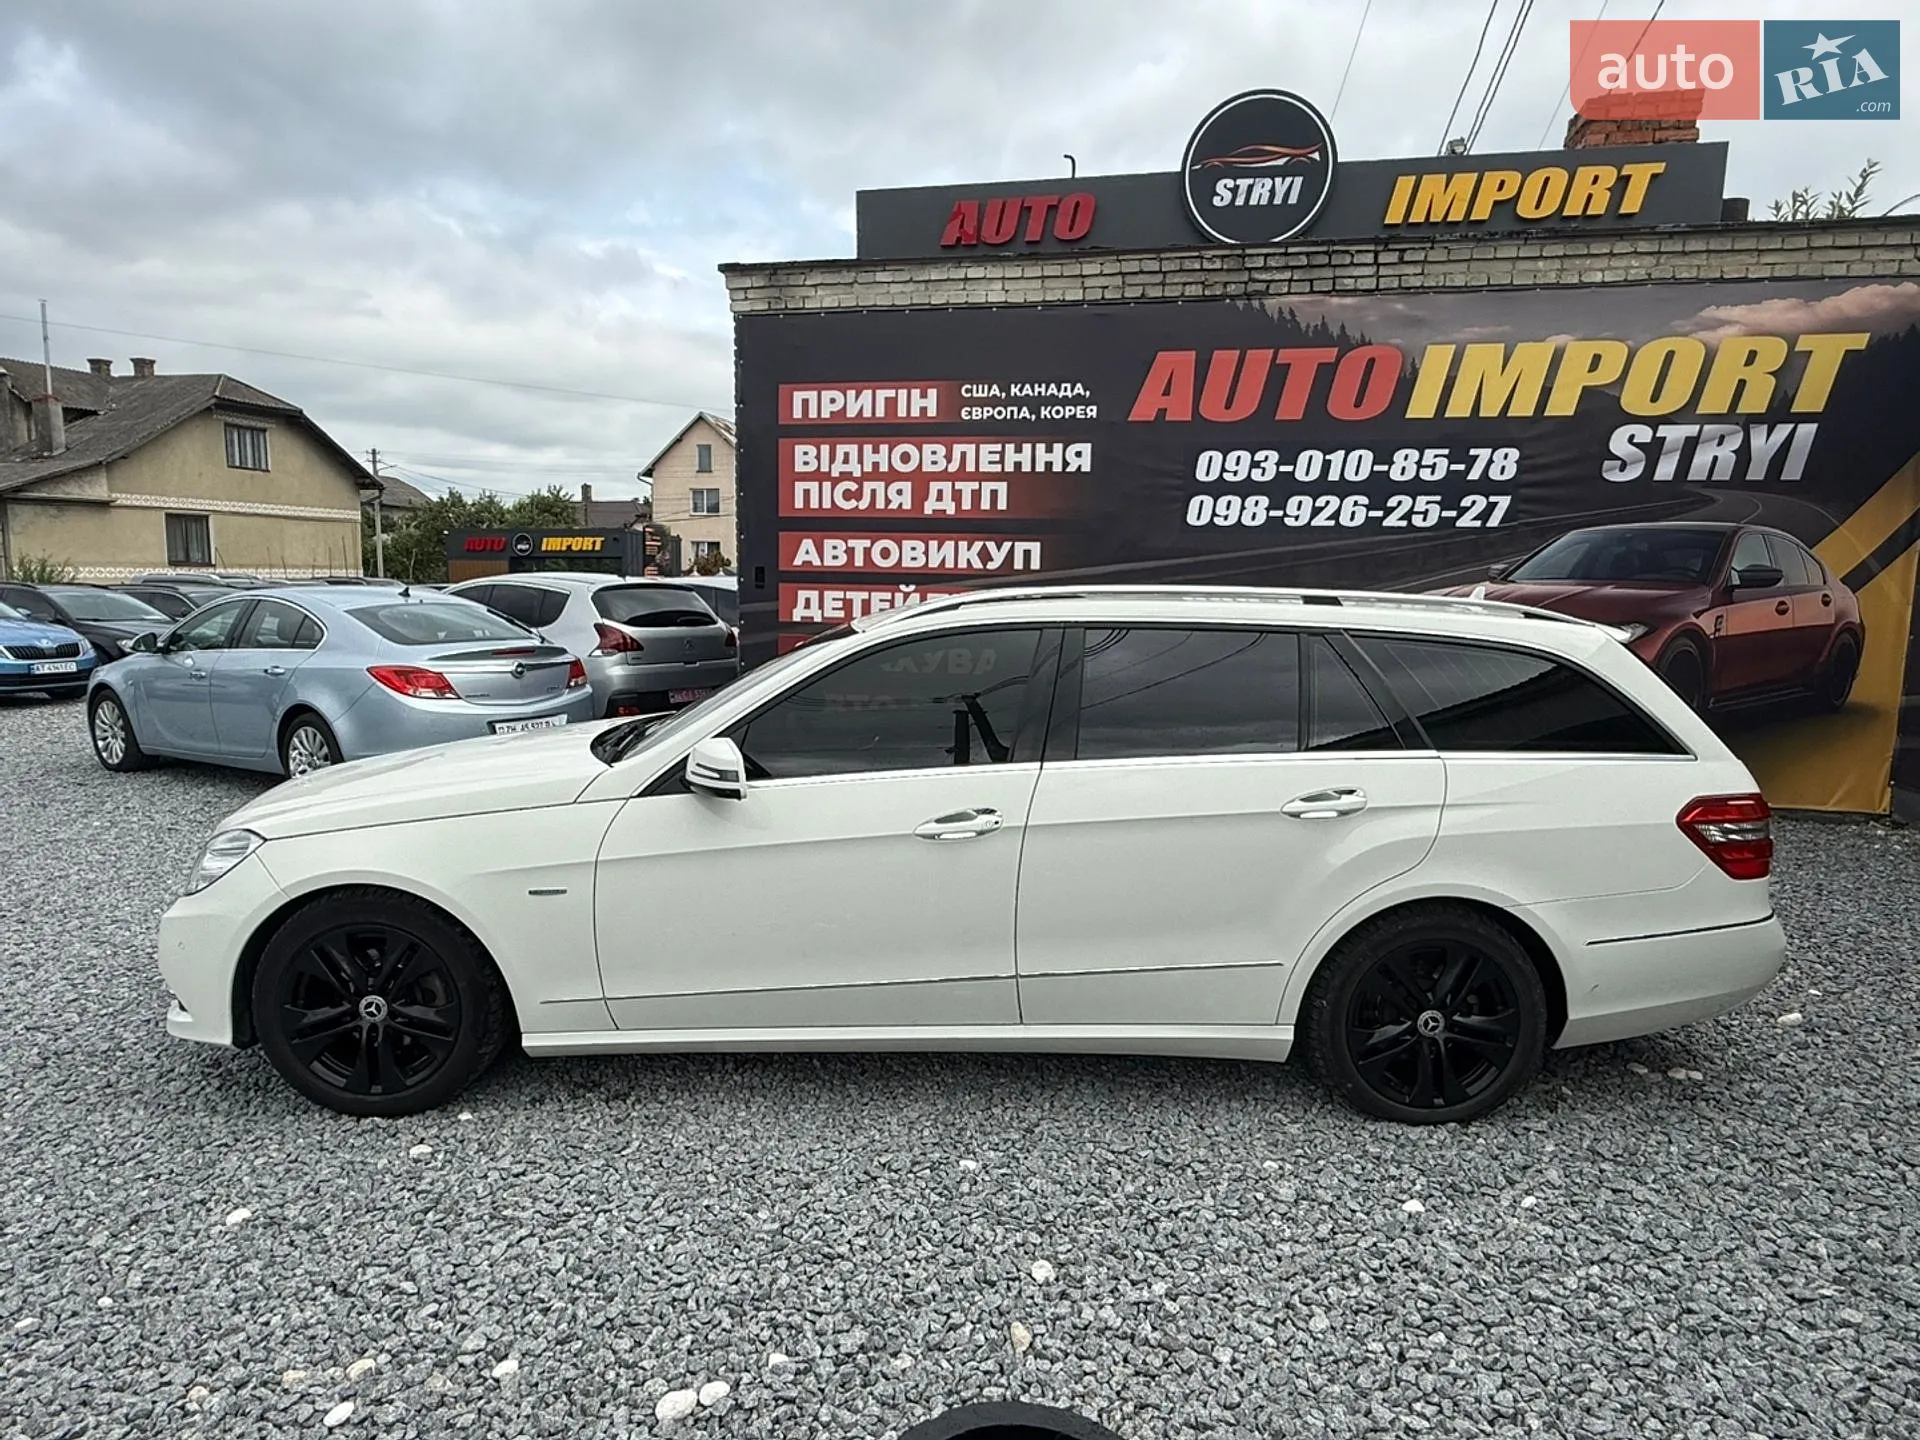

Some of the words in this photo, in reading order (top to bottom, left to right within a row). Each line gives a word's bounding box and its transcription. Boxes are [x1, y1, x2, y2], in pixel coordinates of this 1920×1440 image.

[1212, 176, 1304, 207] STRYI
[1384, 161, 1667, 226] IMPORT
[940, 192, 1096, 247] AUTO
[792, 388, 938, 419] ПРИГІН
[961, 384, 1006, 401] США,
[1010, 383, 1091, 400] КАНАДА,
[961, 406, 1036, 422] ЄВРОПА,
[1040, 405, 1097, 420] КОРЕЯ
[794, 442, 1093, 477] ВІДНОВЛЕННЯ
[1194, 446, 1521, 483] 093-010-85-78
[1601, 422, 1819, 483] STRYI
[794, 481, 912, 510] ПІСЛЯ
[924, 481, 1009, 515] ДТП
[1185, 494, 1513, 528] 098-926-25-27
[541, 537, 605, 552] IMPORT
[792, 539, 1042, 571] АВТОВИКУП
